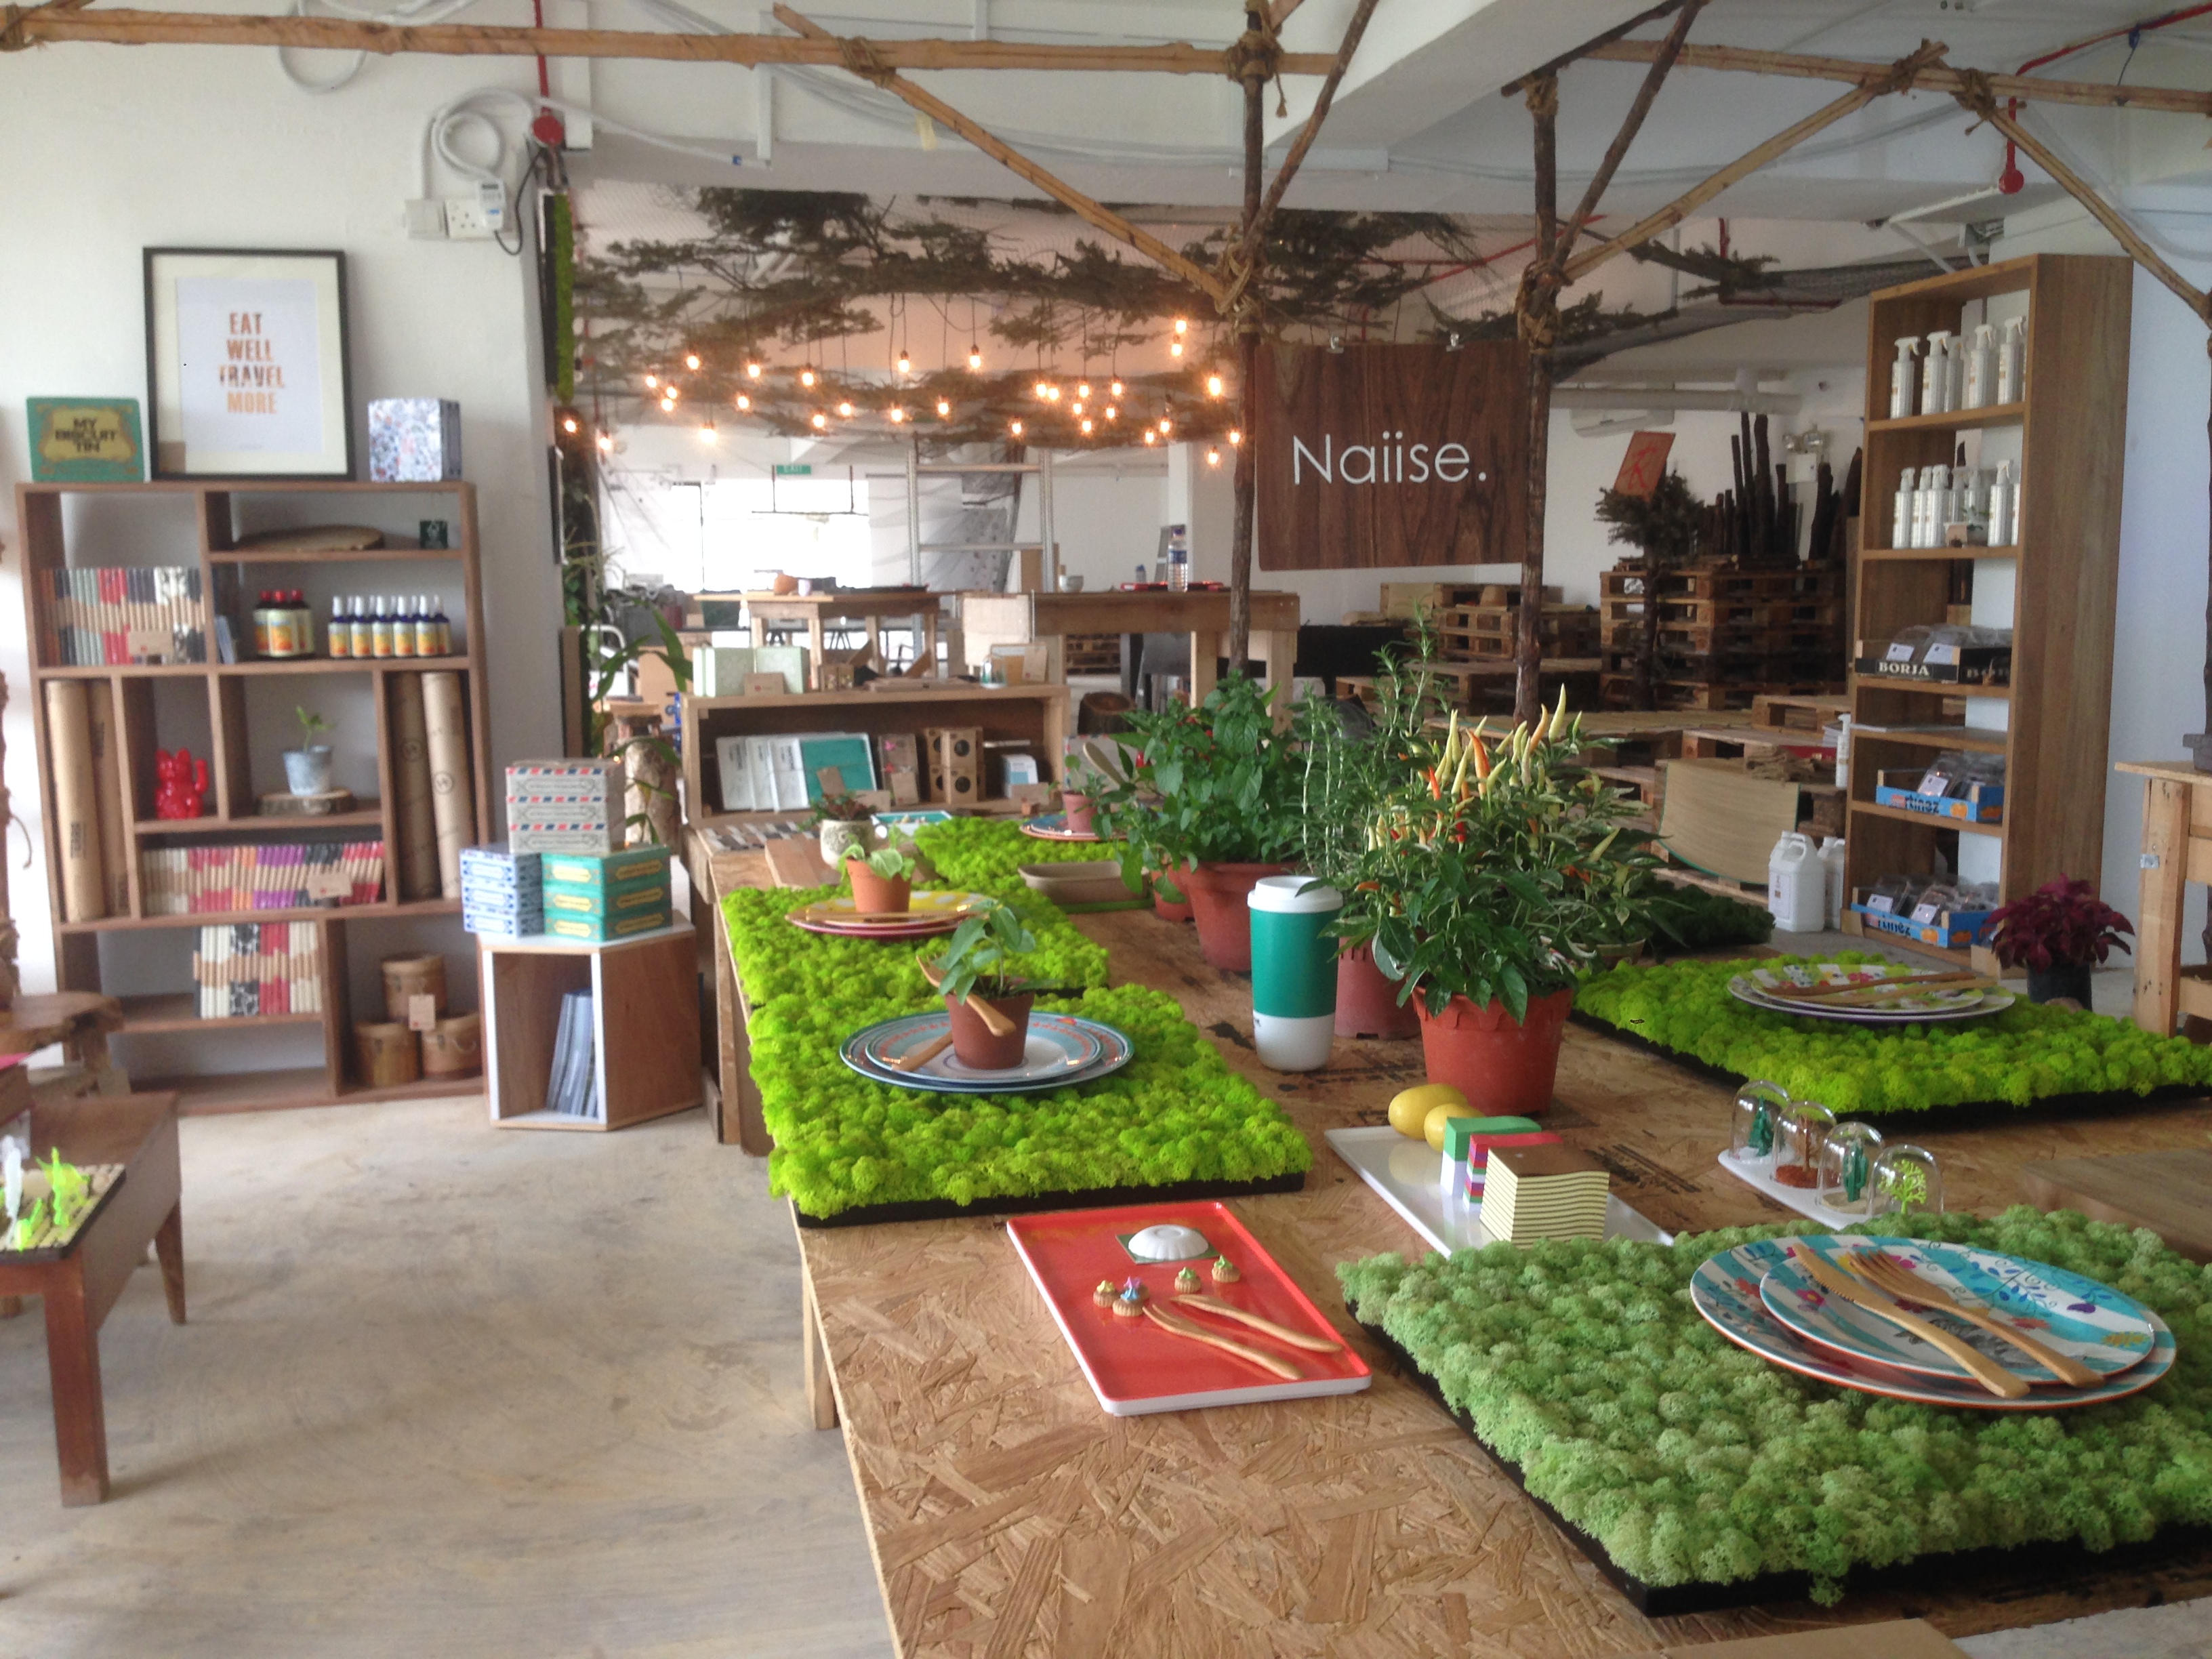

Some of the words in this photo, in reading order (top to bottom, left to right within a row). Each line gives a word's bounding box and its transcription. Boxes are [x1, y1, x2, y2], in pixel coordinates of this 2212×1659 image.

[229, 312, 263, 335] EAT
[227, 340, 274, 361] WELL
[219, 365, 285, 388] TRAVEL
[227, 391, 277, 414] MORE
[73, 417, 98, 430] MY
[1293, 430, 1487, 485] Naiise.
[1878, 661, 1930, 676] BORJA
